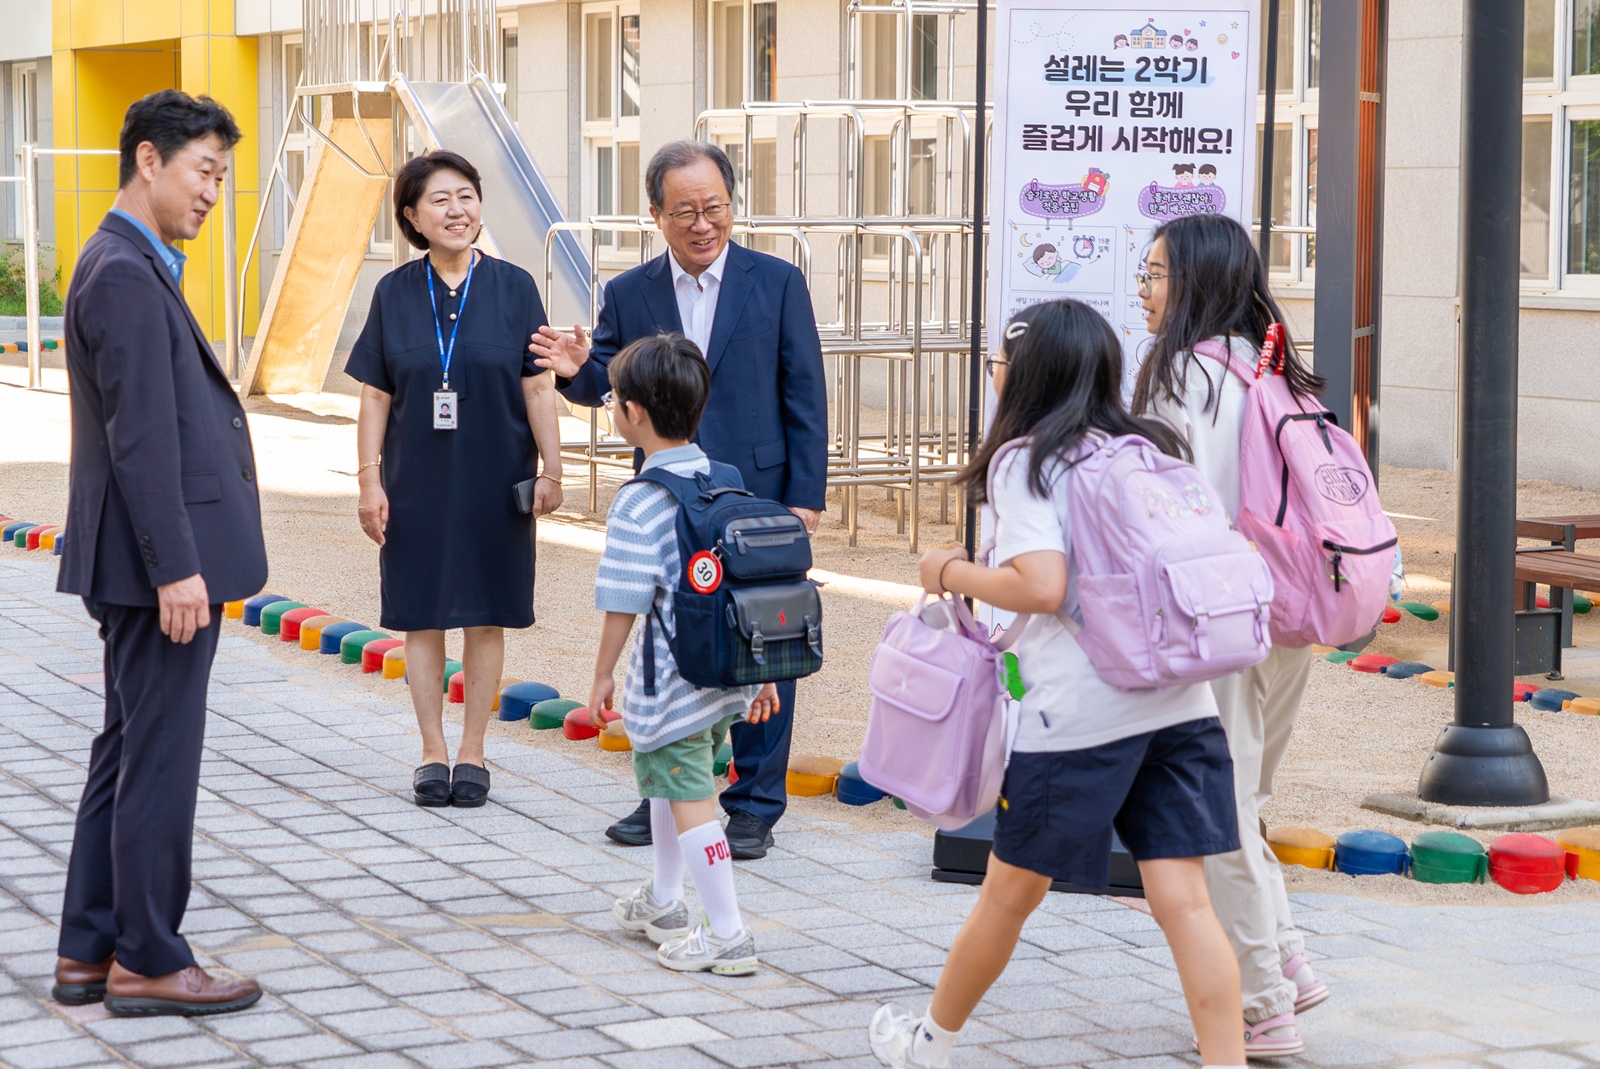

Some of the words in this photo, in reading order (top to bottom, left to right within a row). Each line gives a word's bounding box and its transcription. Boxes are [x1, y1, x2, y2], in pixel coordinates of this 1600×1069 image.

[1043, 54, 1125, 83] 설레는
[1134, 55, 1208, 84] 2학기
[1064, 90, 1118, 117] 우리
[1128, 90, 1183, 119] 함께
[1022, 124, 1103, 152] 즐겁게
[1111, 125, 1233, 155] 시작해요!
[1025, 189, 1060, 201] 슬기로운
[1061, 189, 1098, 202] 학교생활
[1153, 192, 1180, 203] 틀려도
[1181, 192, 1212, 204] 괜찮아!
[1042, 201, 1060, 213] 적응
[1061, 201, 1079, 213] 꿀팁
[1148, 203, 1168, 215] 함께
[1169, 203, 1197, 215] 배우는
[696, 561, 713, 582] 30
